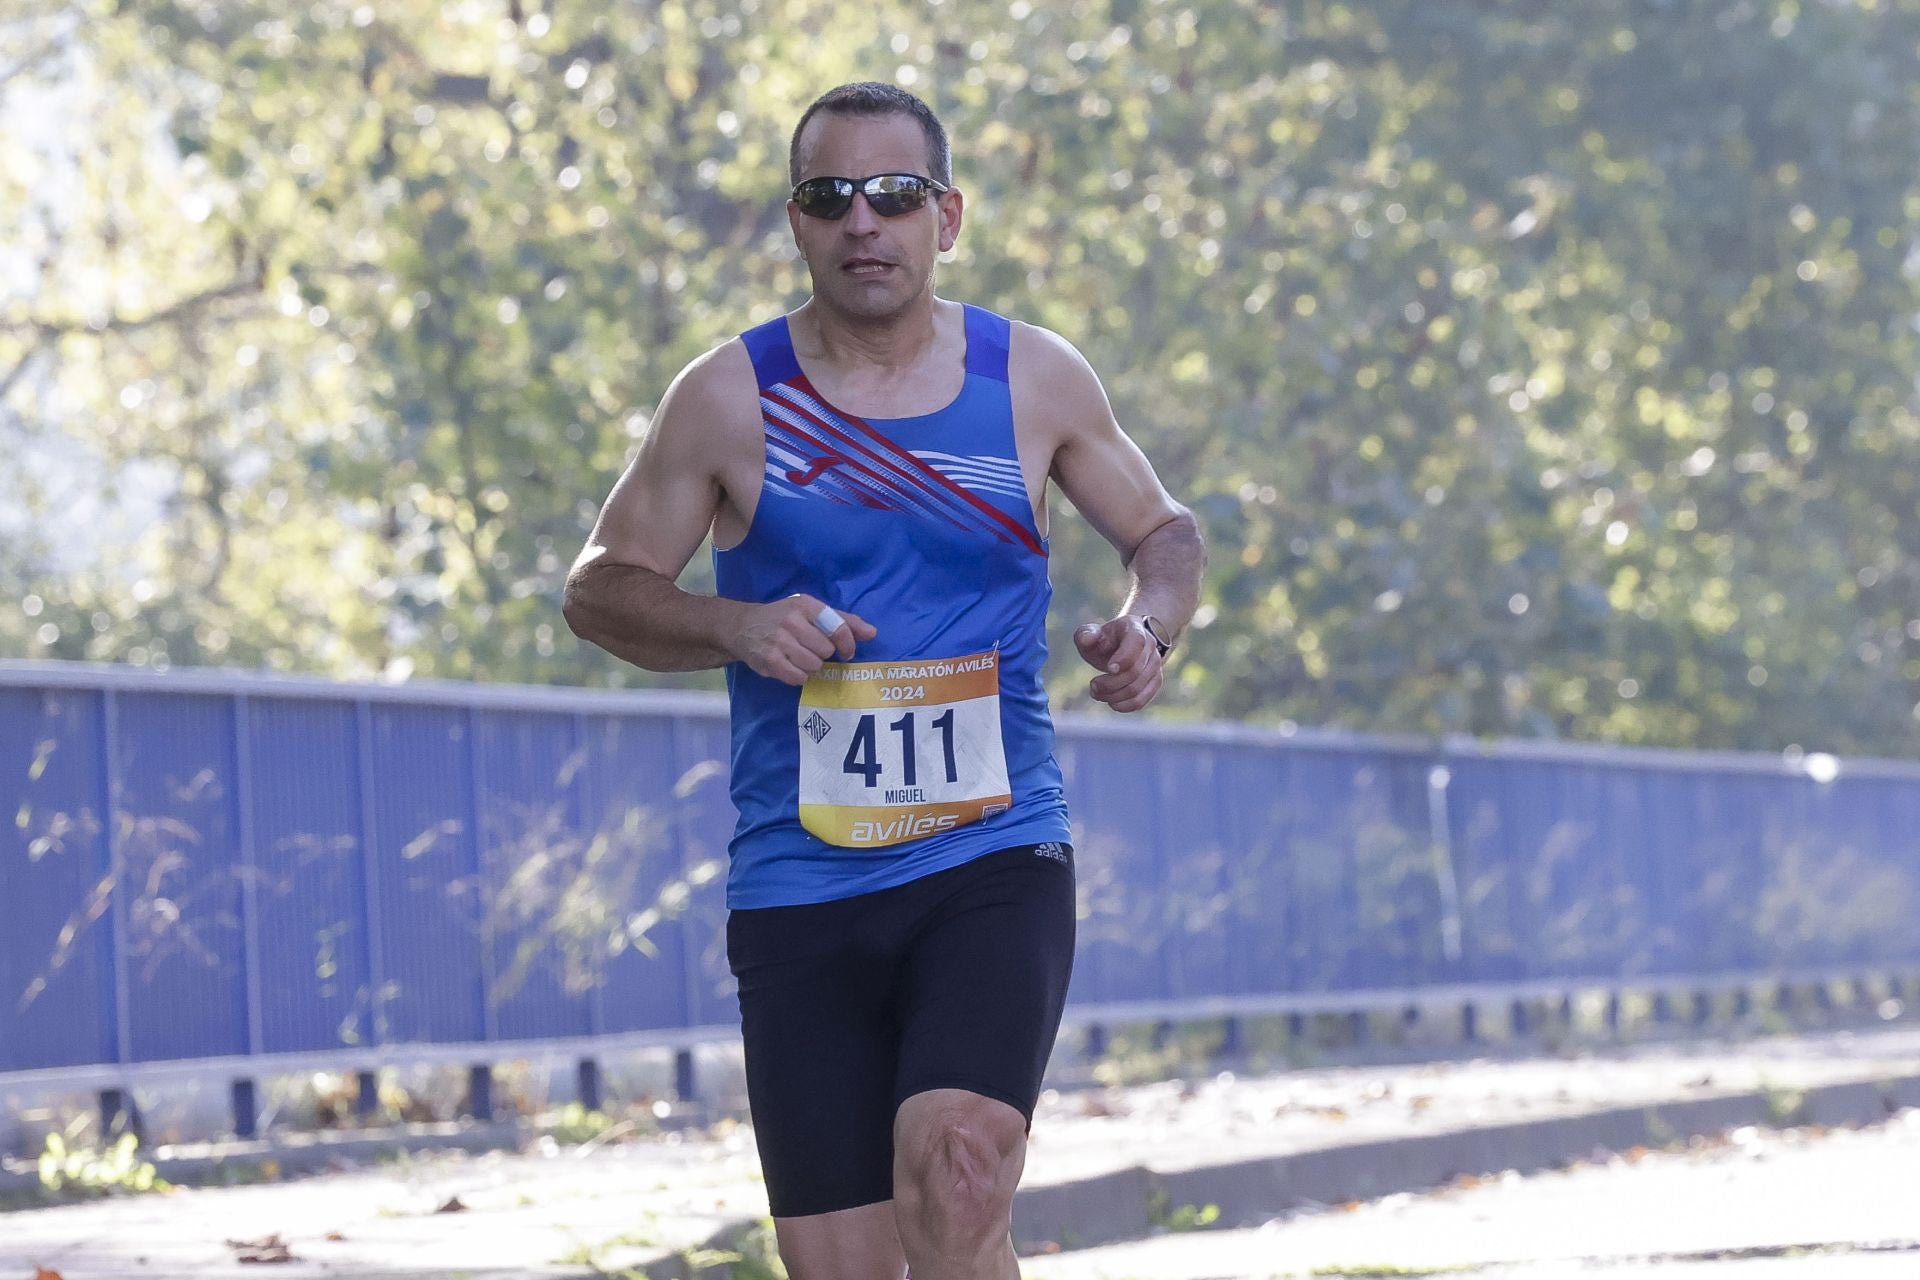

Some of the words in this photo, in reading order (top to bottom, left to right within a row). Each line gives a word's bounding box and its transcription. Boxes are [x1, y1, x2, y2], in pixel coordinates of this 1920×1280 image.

[842, 668, 883, 681] MEDIA
[887, 662, 954, 680] MARATÓN
[956, 655, 994, 674] AVILÉS
[880, 686, 925, 700] 2024
[843, 709, 958, 788] 411
[885, 789, 926, 804] MIGUEL
[851, 813, 959, 842] avilés
[1035, 849, 1068, 864] adidas
